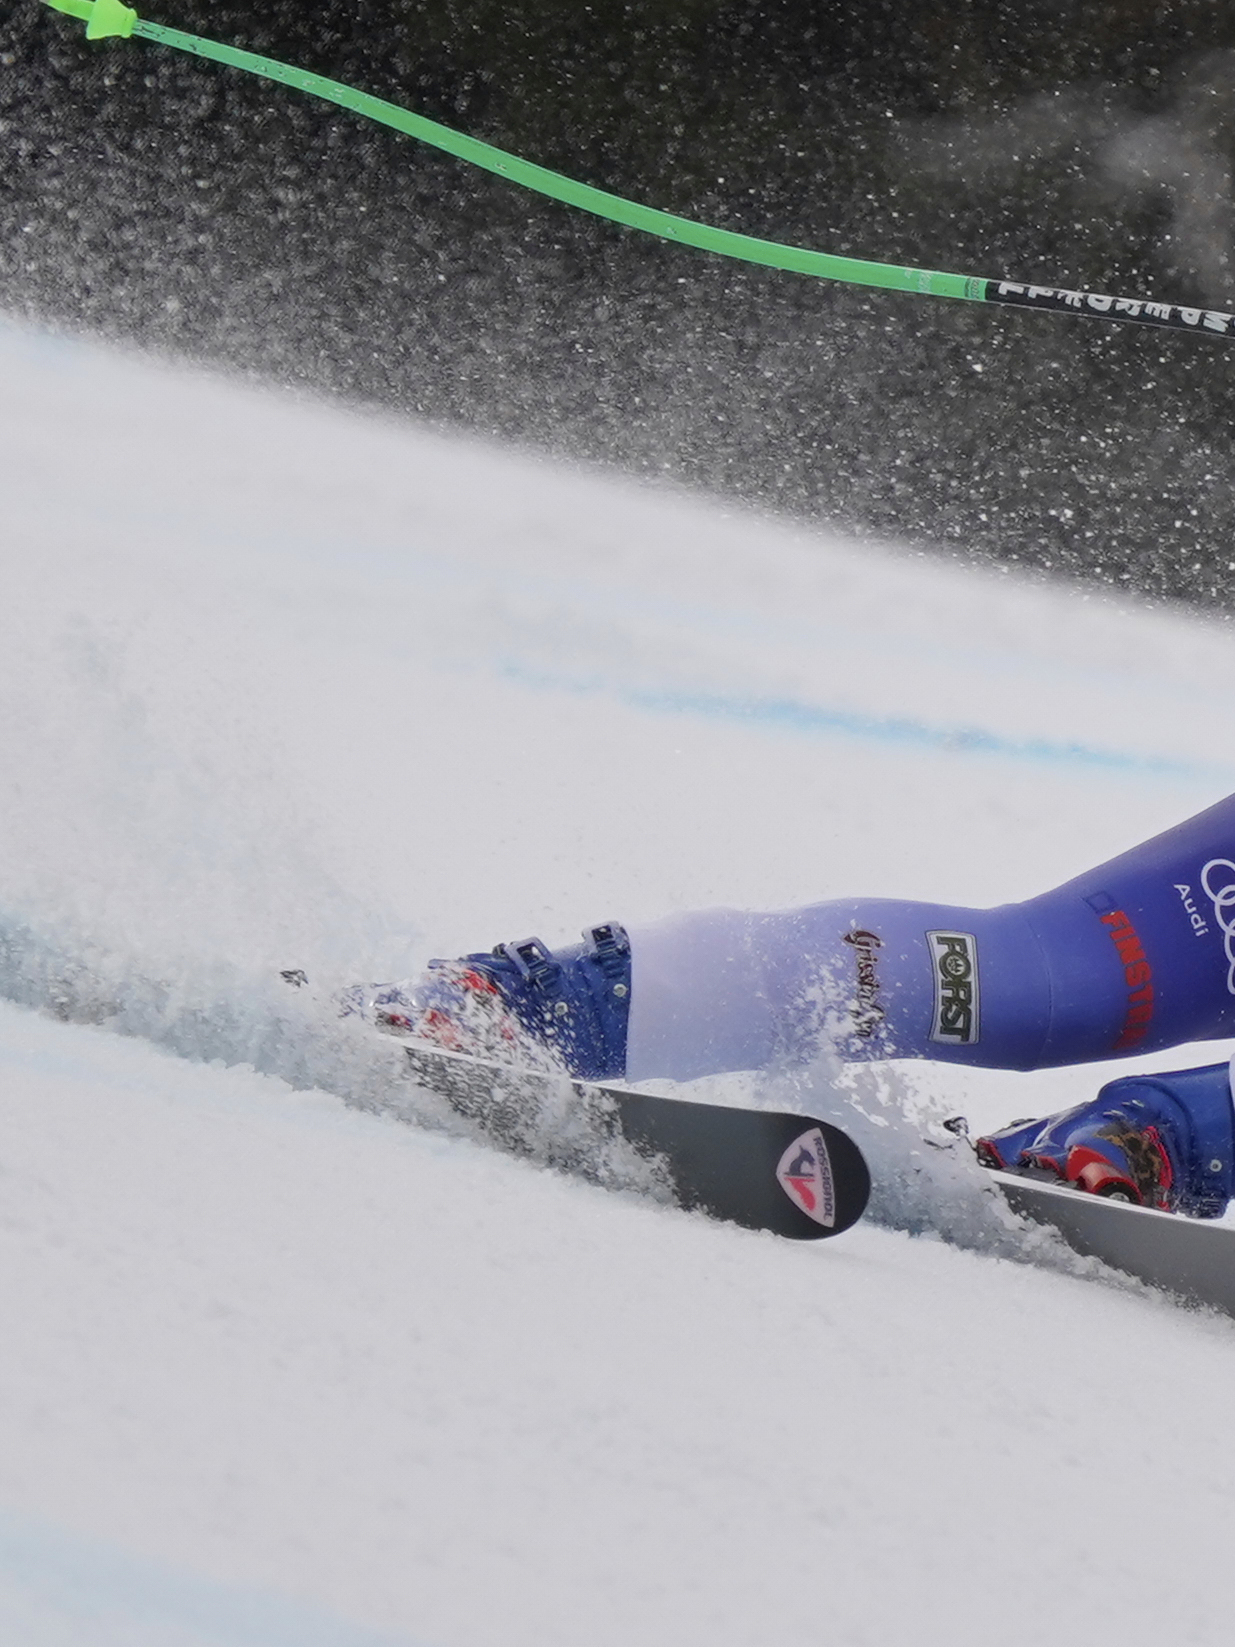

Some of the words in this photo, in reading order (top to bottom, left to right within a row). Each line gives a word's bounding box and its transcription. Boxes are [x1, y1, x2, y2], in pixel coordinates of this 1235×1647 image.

[1174, 883, 1209, 938] Audi
[937, 936, 973, 1042] FORST
[1101, 910, 1153, 1050] FINSTRA
[813, 1136, 833, 1221] ROSSIGNOL
